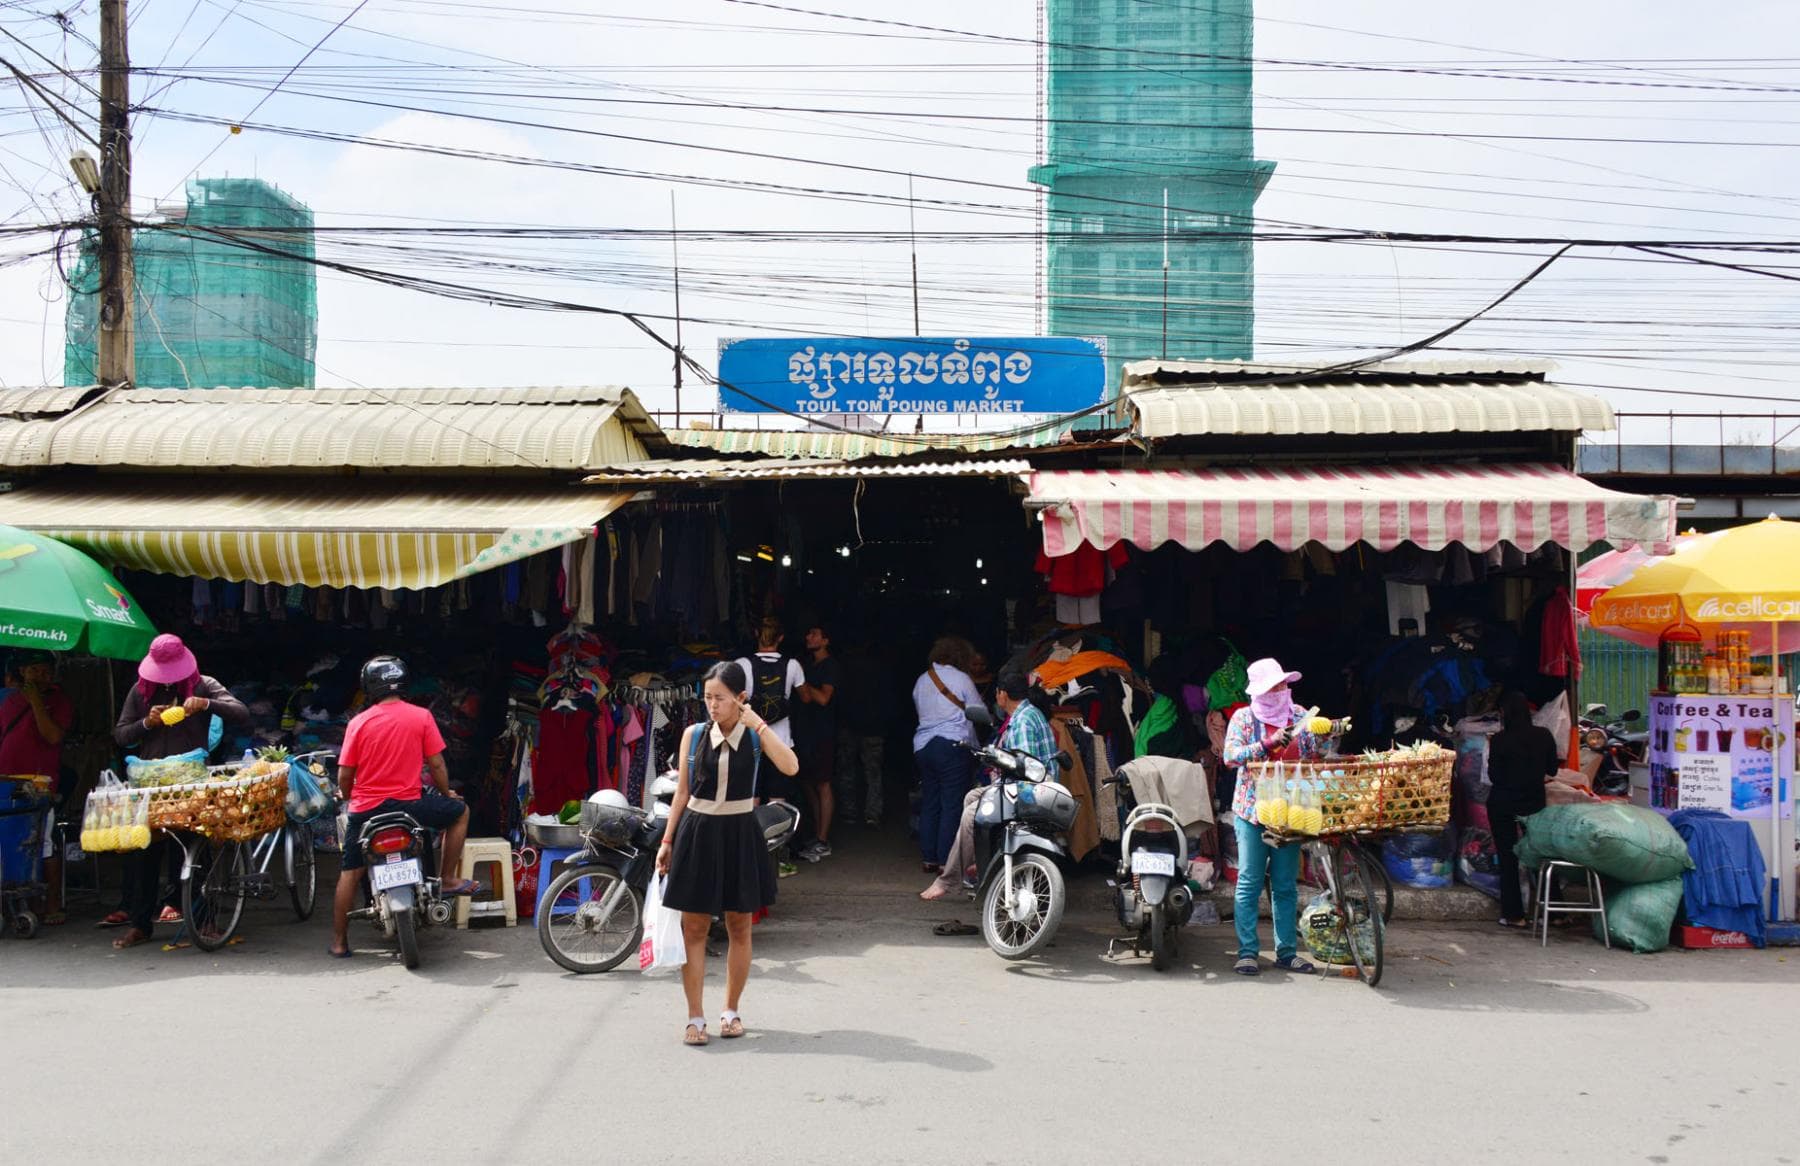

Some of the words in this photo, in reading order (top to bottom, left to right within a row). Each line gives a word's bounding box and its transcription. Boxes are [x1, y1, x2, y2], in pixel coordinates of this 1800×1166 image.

[796, 400, 841, 412] TOUL
[846, 400, 883, 412] TOM
[888, 400, 948, 412] POUNG
[953, 400, 1024, 412] MARKET
[85, 597, 136, 625] Smart
[1657, 702, 1709, 717] Coffee
[1716, 703, 1730, 717] &
[1736, 704, 1773, 718] Tea
